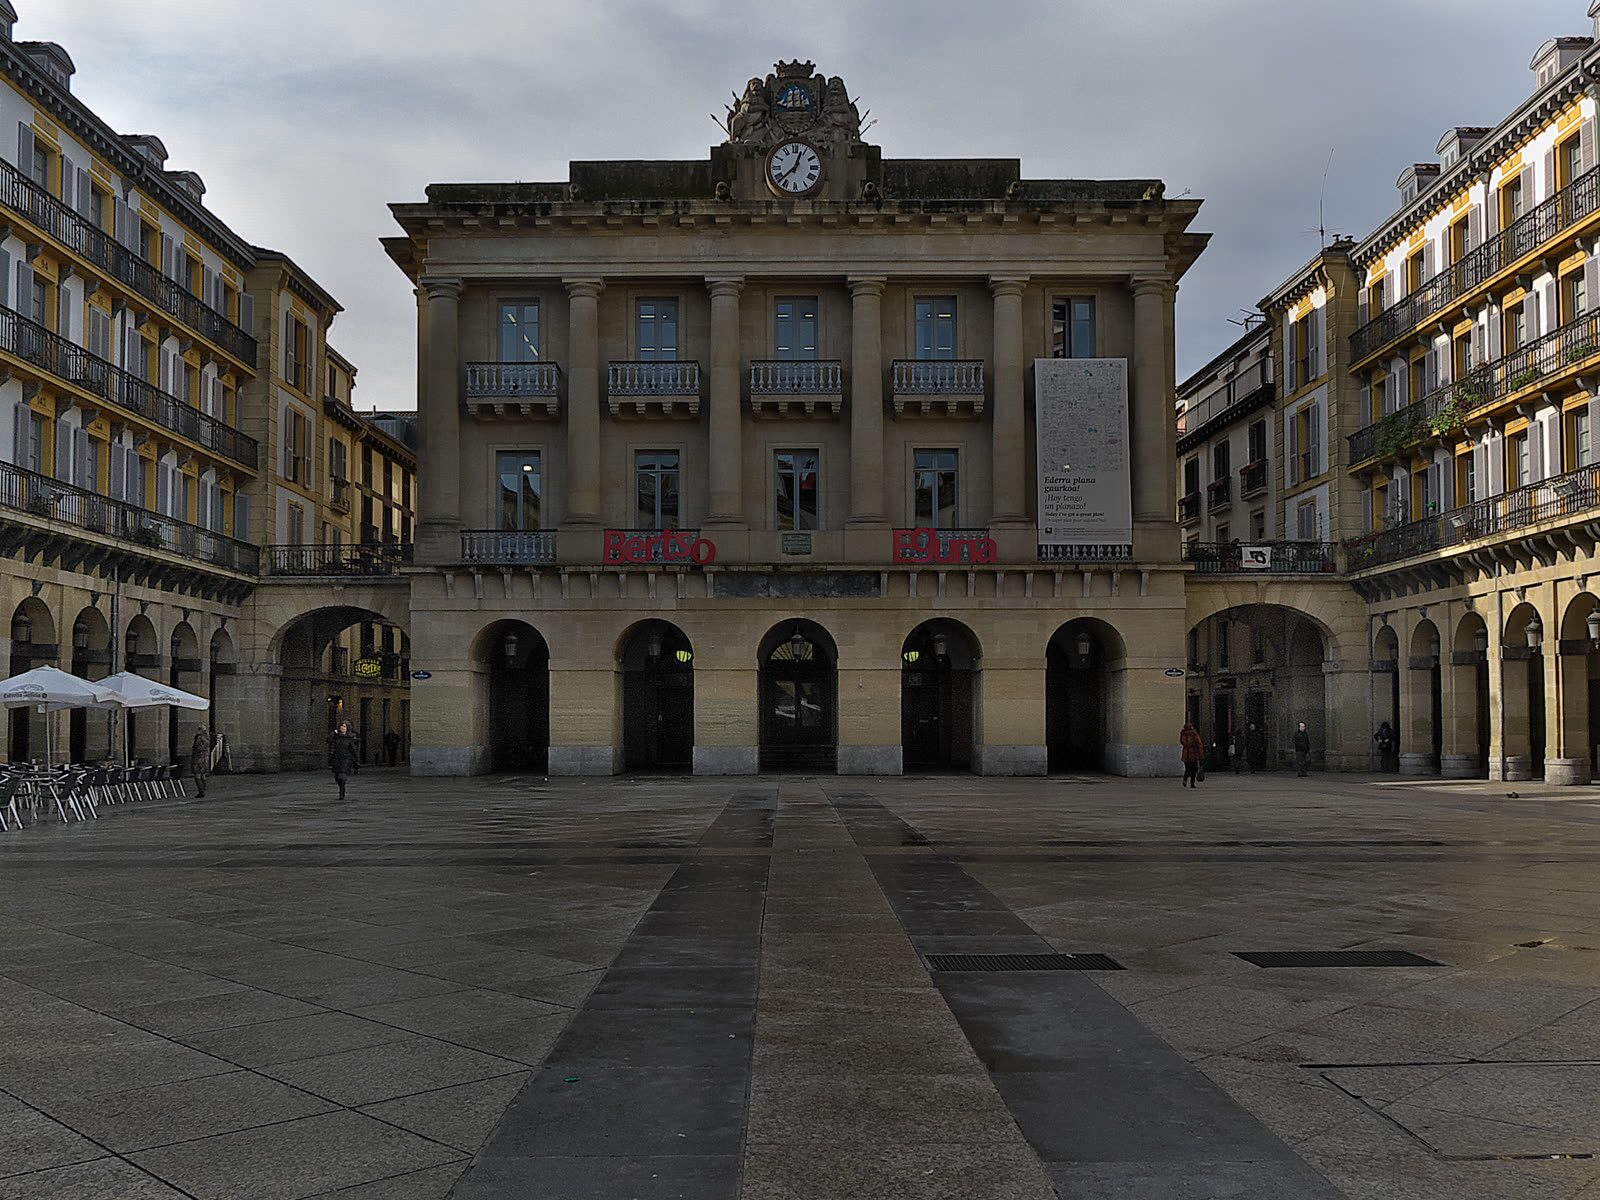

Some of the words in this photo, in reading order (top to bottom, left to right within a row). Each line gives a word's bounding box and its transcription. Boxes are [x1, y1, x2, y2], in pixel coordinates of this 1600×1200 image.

[1073, 477, 1096, 485] plana
[1044, 485, 1080, 493] gaurkoa!
[1063, 495, 1083, 503] tengo
[1056, 503, 1086, 511] planazo!
[602, 528, 715, 565] Bertso
[892, 527, 997, 564] Eguna
